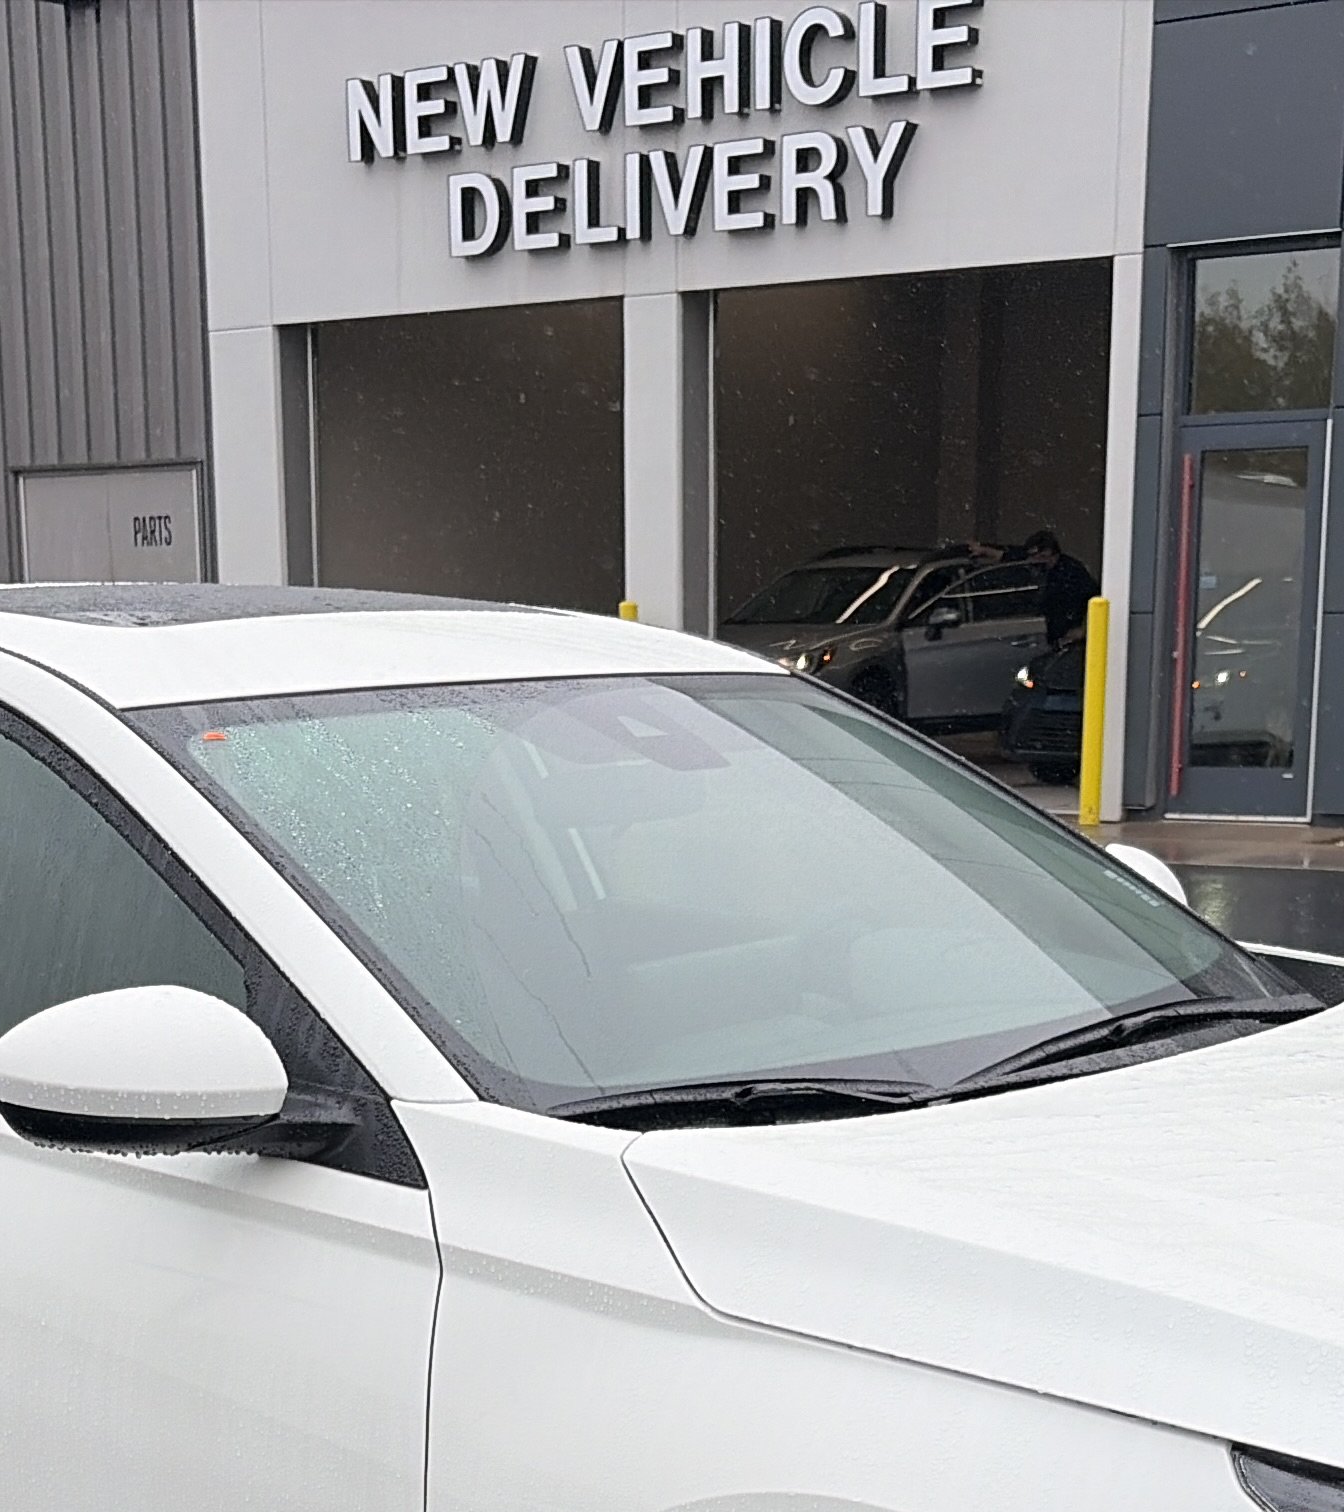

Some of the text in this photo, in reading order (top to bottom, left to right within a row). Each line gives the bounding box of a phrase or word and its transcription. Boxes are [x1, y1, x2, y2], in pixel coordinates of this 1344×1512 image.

[346, 0, 984, 163] NEW VEHICLE
[449, 121, 917, 258] DELIVERY
[133, 514, 172, 547] PARTS
